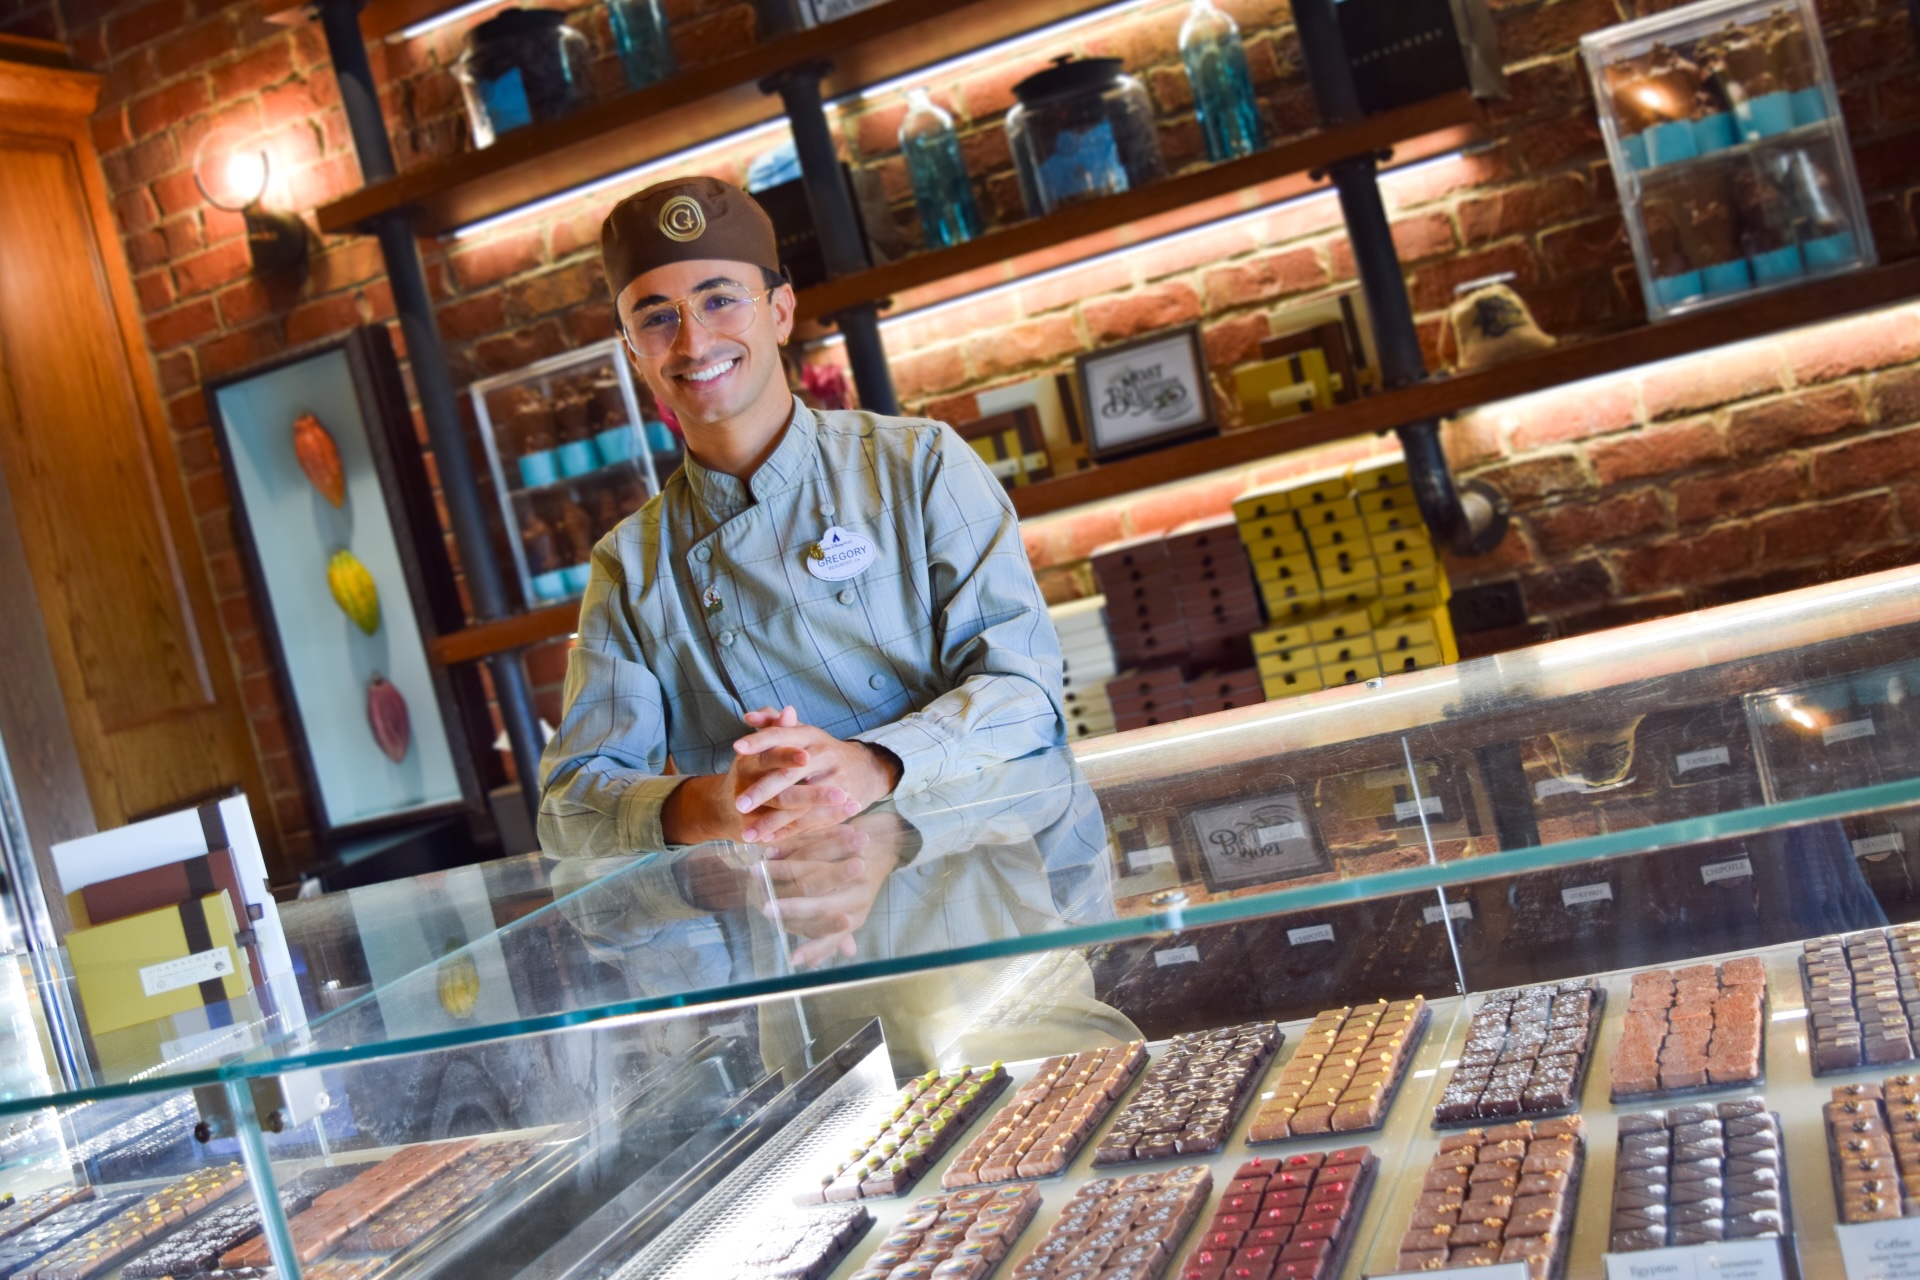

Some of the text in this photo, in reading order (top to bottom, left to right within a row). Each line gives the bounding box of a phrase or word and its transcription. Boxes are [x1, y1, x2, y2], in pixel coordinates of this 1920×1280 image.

[817, 546, 866, 567] GREGORY
[1705, 862, 1745, 877] CHIPOTLE
[1875, 1238, 1911, 1250] Coffee
[1629, 1263, 1679, 1278] Egyptian
